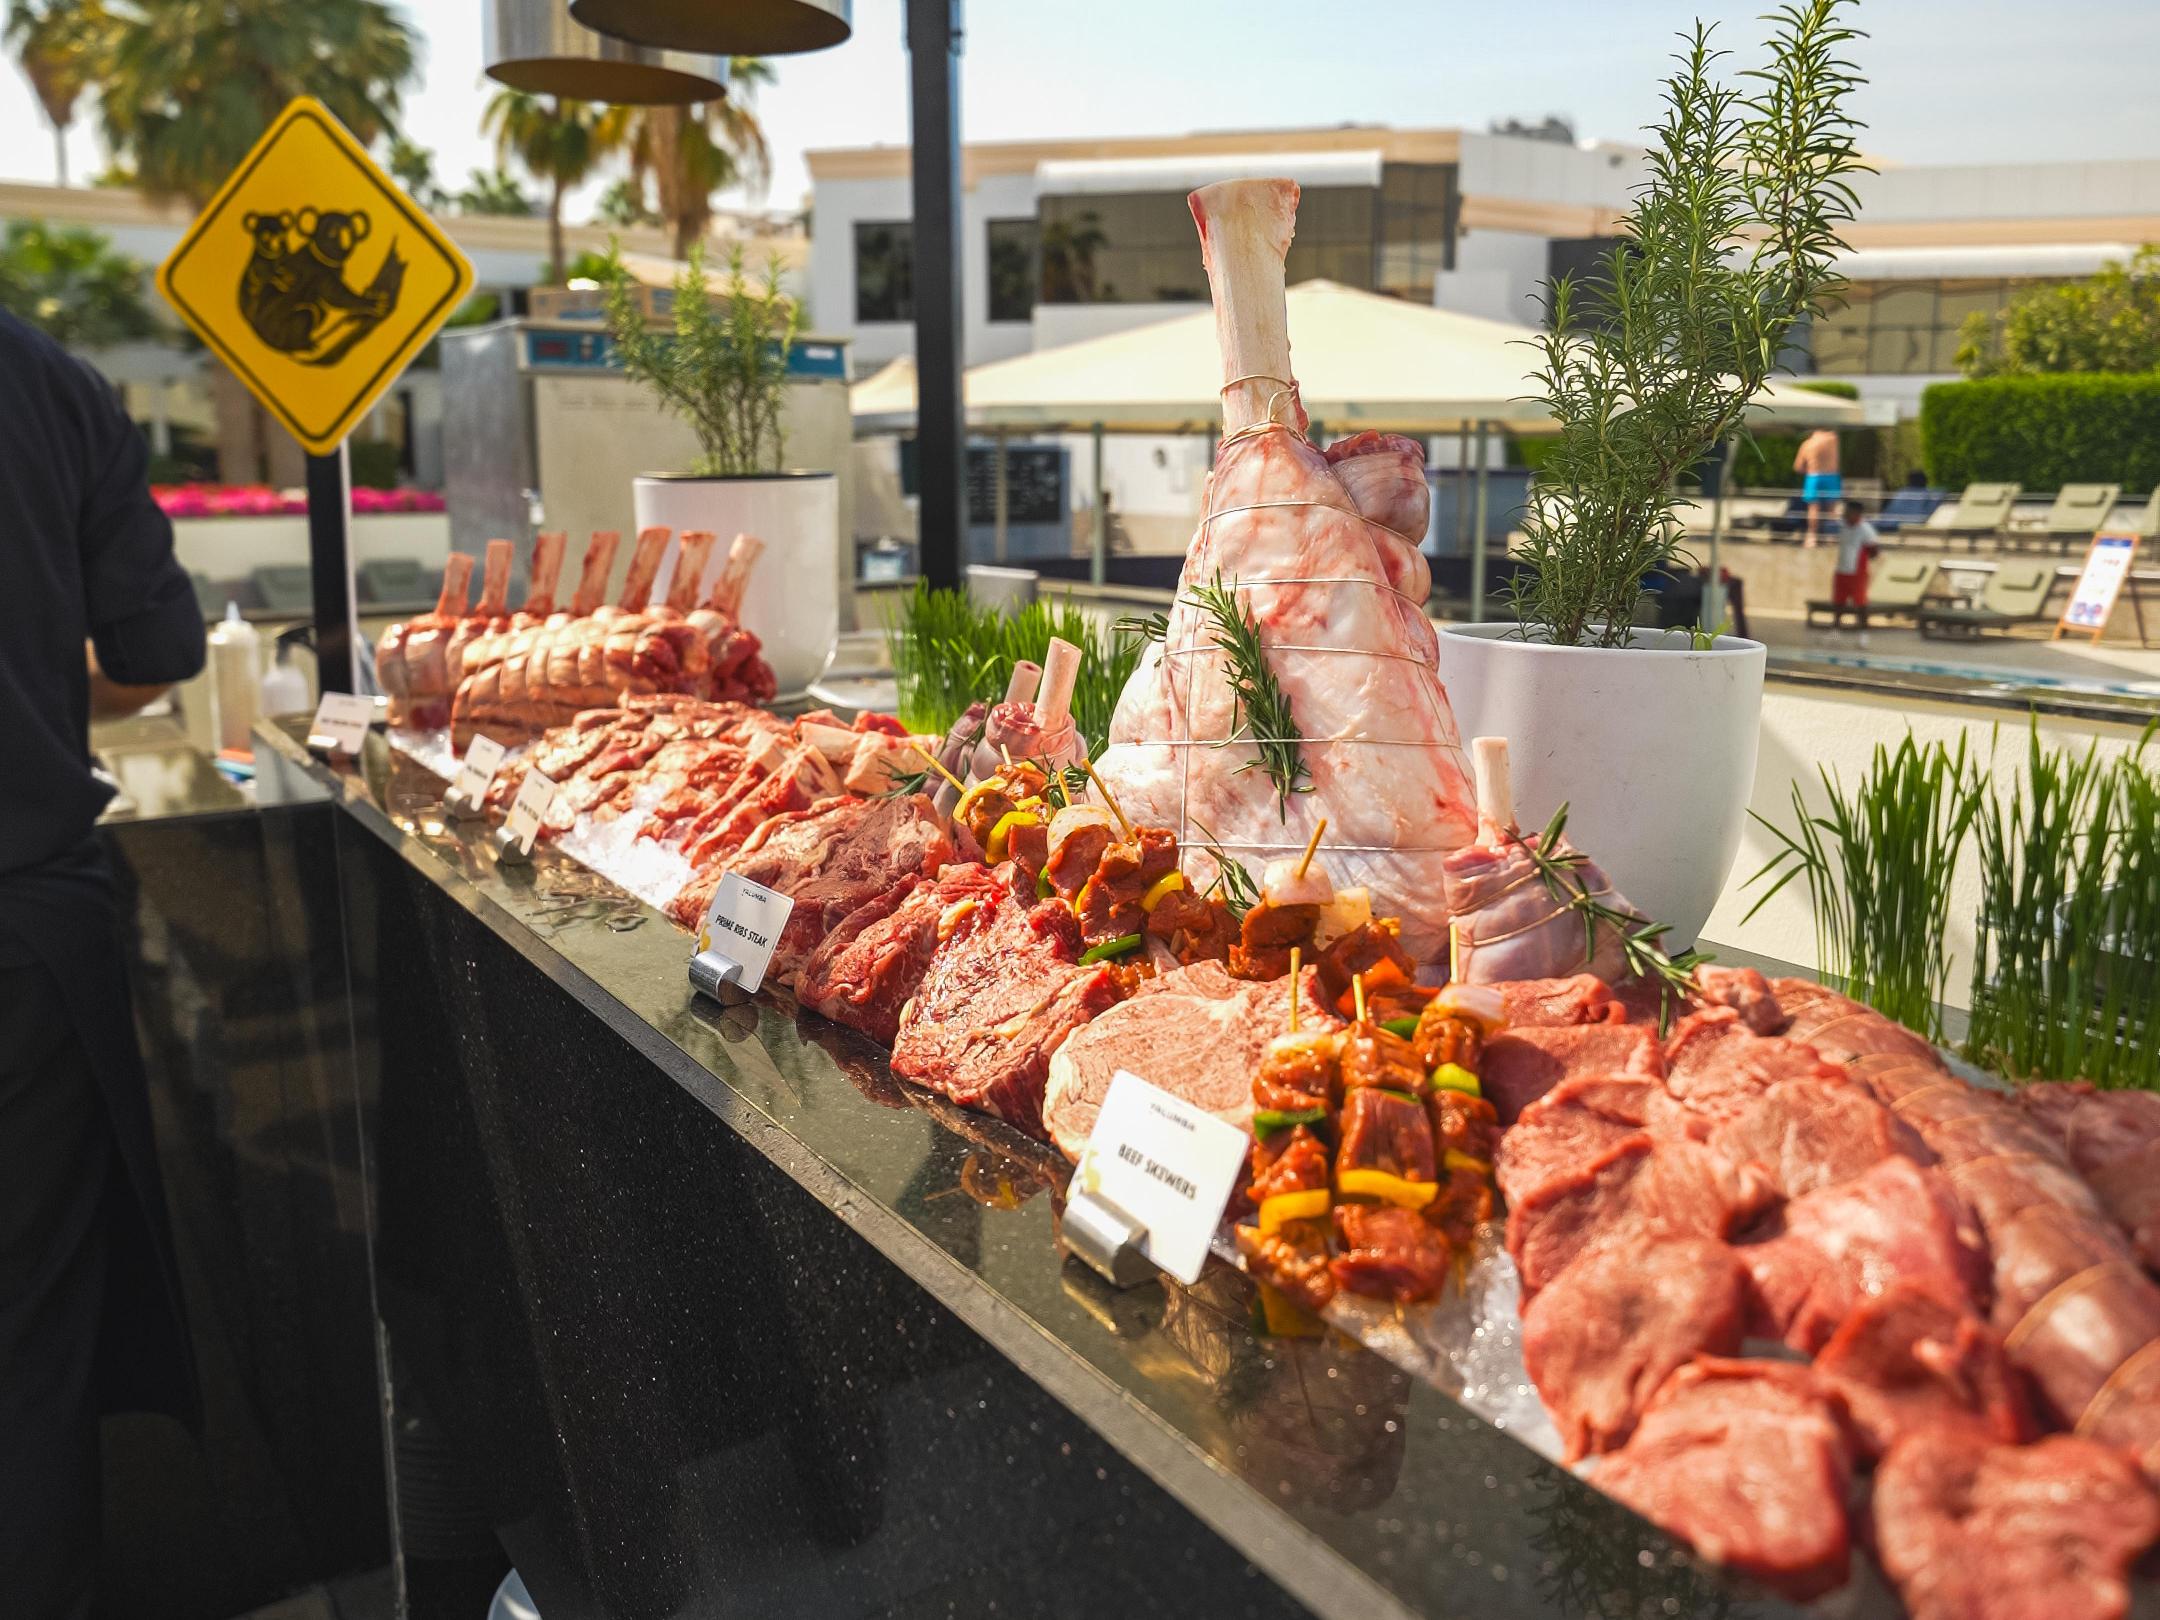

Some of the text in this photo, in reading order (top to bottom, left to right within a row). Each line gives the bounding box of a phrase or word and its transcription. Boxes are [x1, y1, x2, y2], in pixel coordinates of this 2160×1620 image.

[715, 914, 735, 931] PRIME
[747, 931, 768, 948] STEAK
[1118, 1143, 1197, 1200] BEEF SKEWERS
